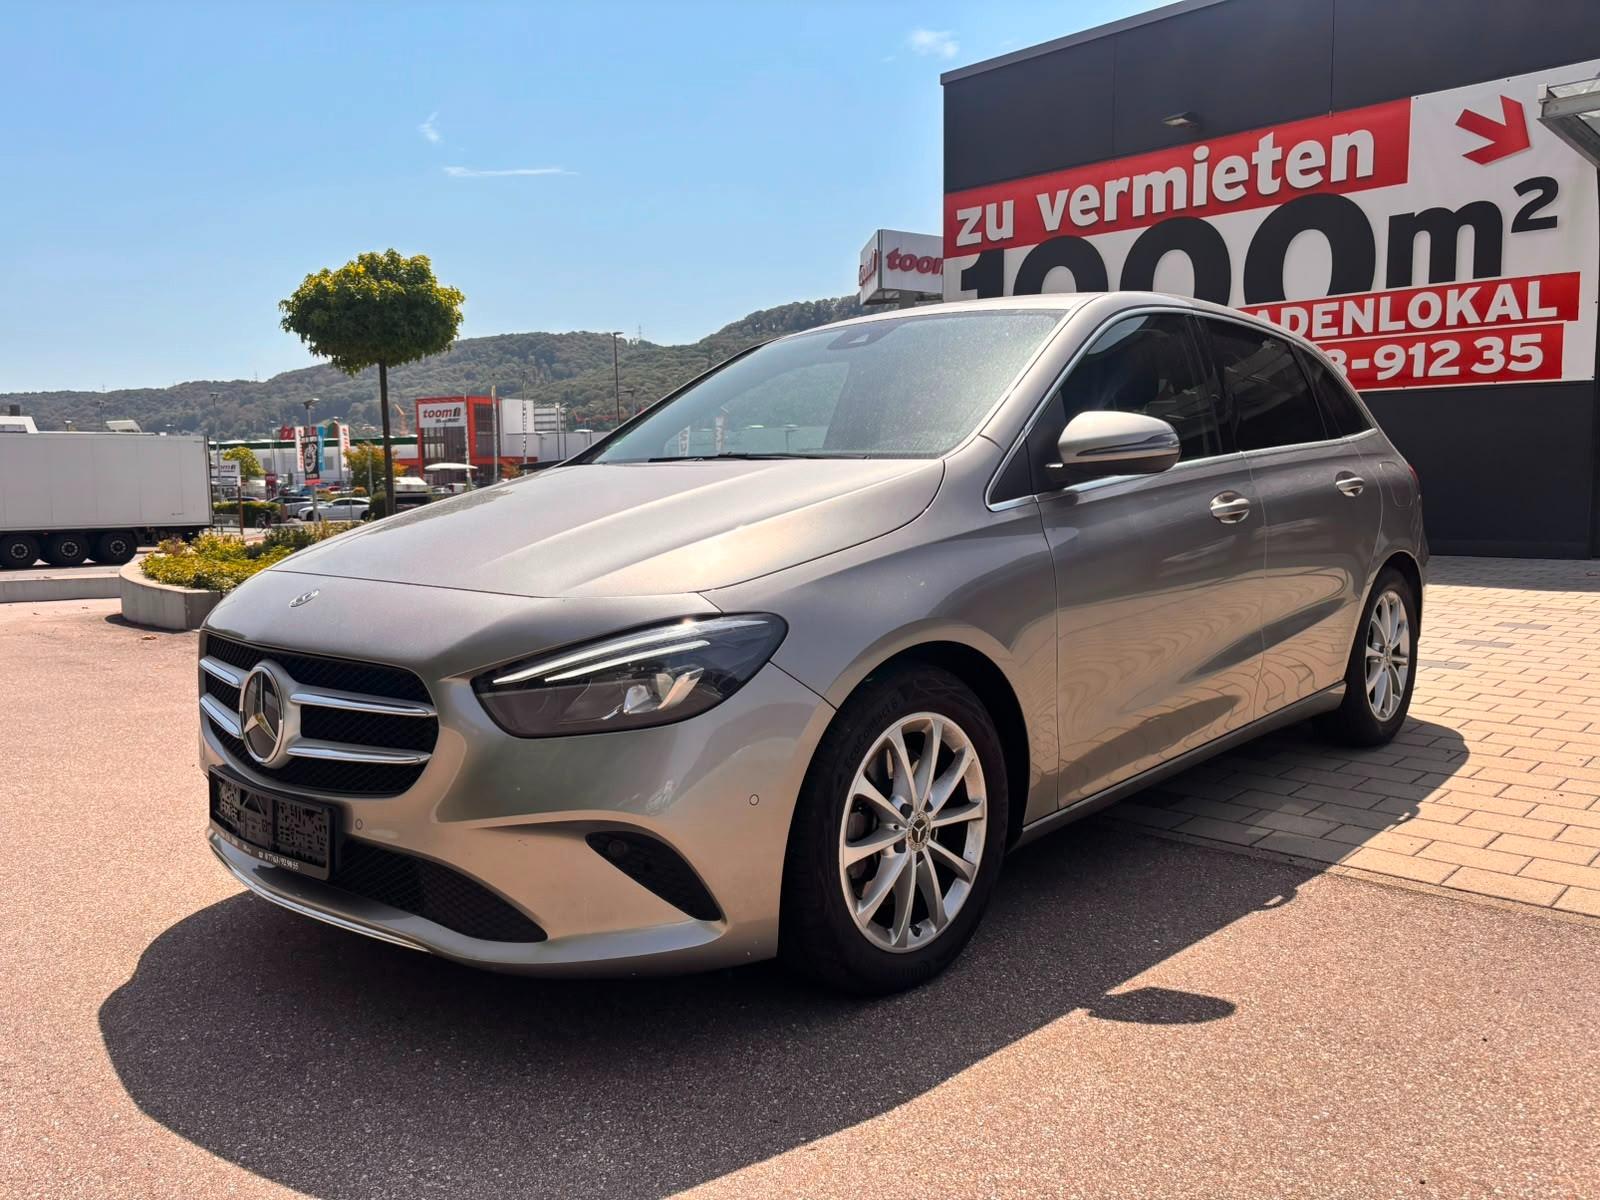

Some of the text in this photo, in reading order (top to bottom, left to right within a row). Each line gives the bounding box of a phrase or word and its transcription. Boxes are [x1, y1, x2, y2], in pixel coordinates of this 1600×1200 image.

[955, 129, 1376, 247] zu vermieten
[1470, 333, 1544, 375] 35
[423, 408, 452, 419] toom
